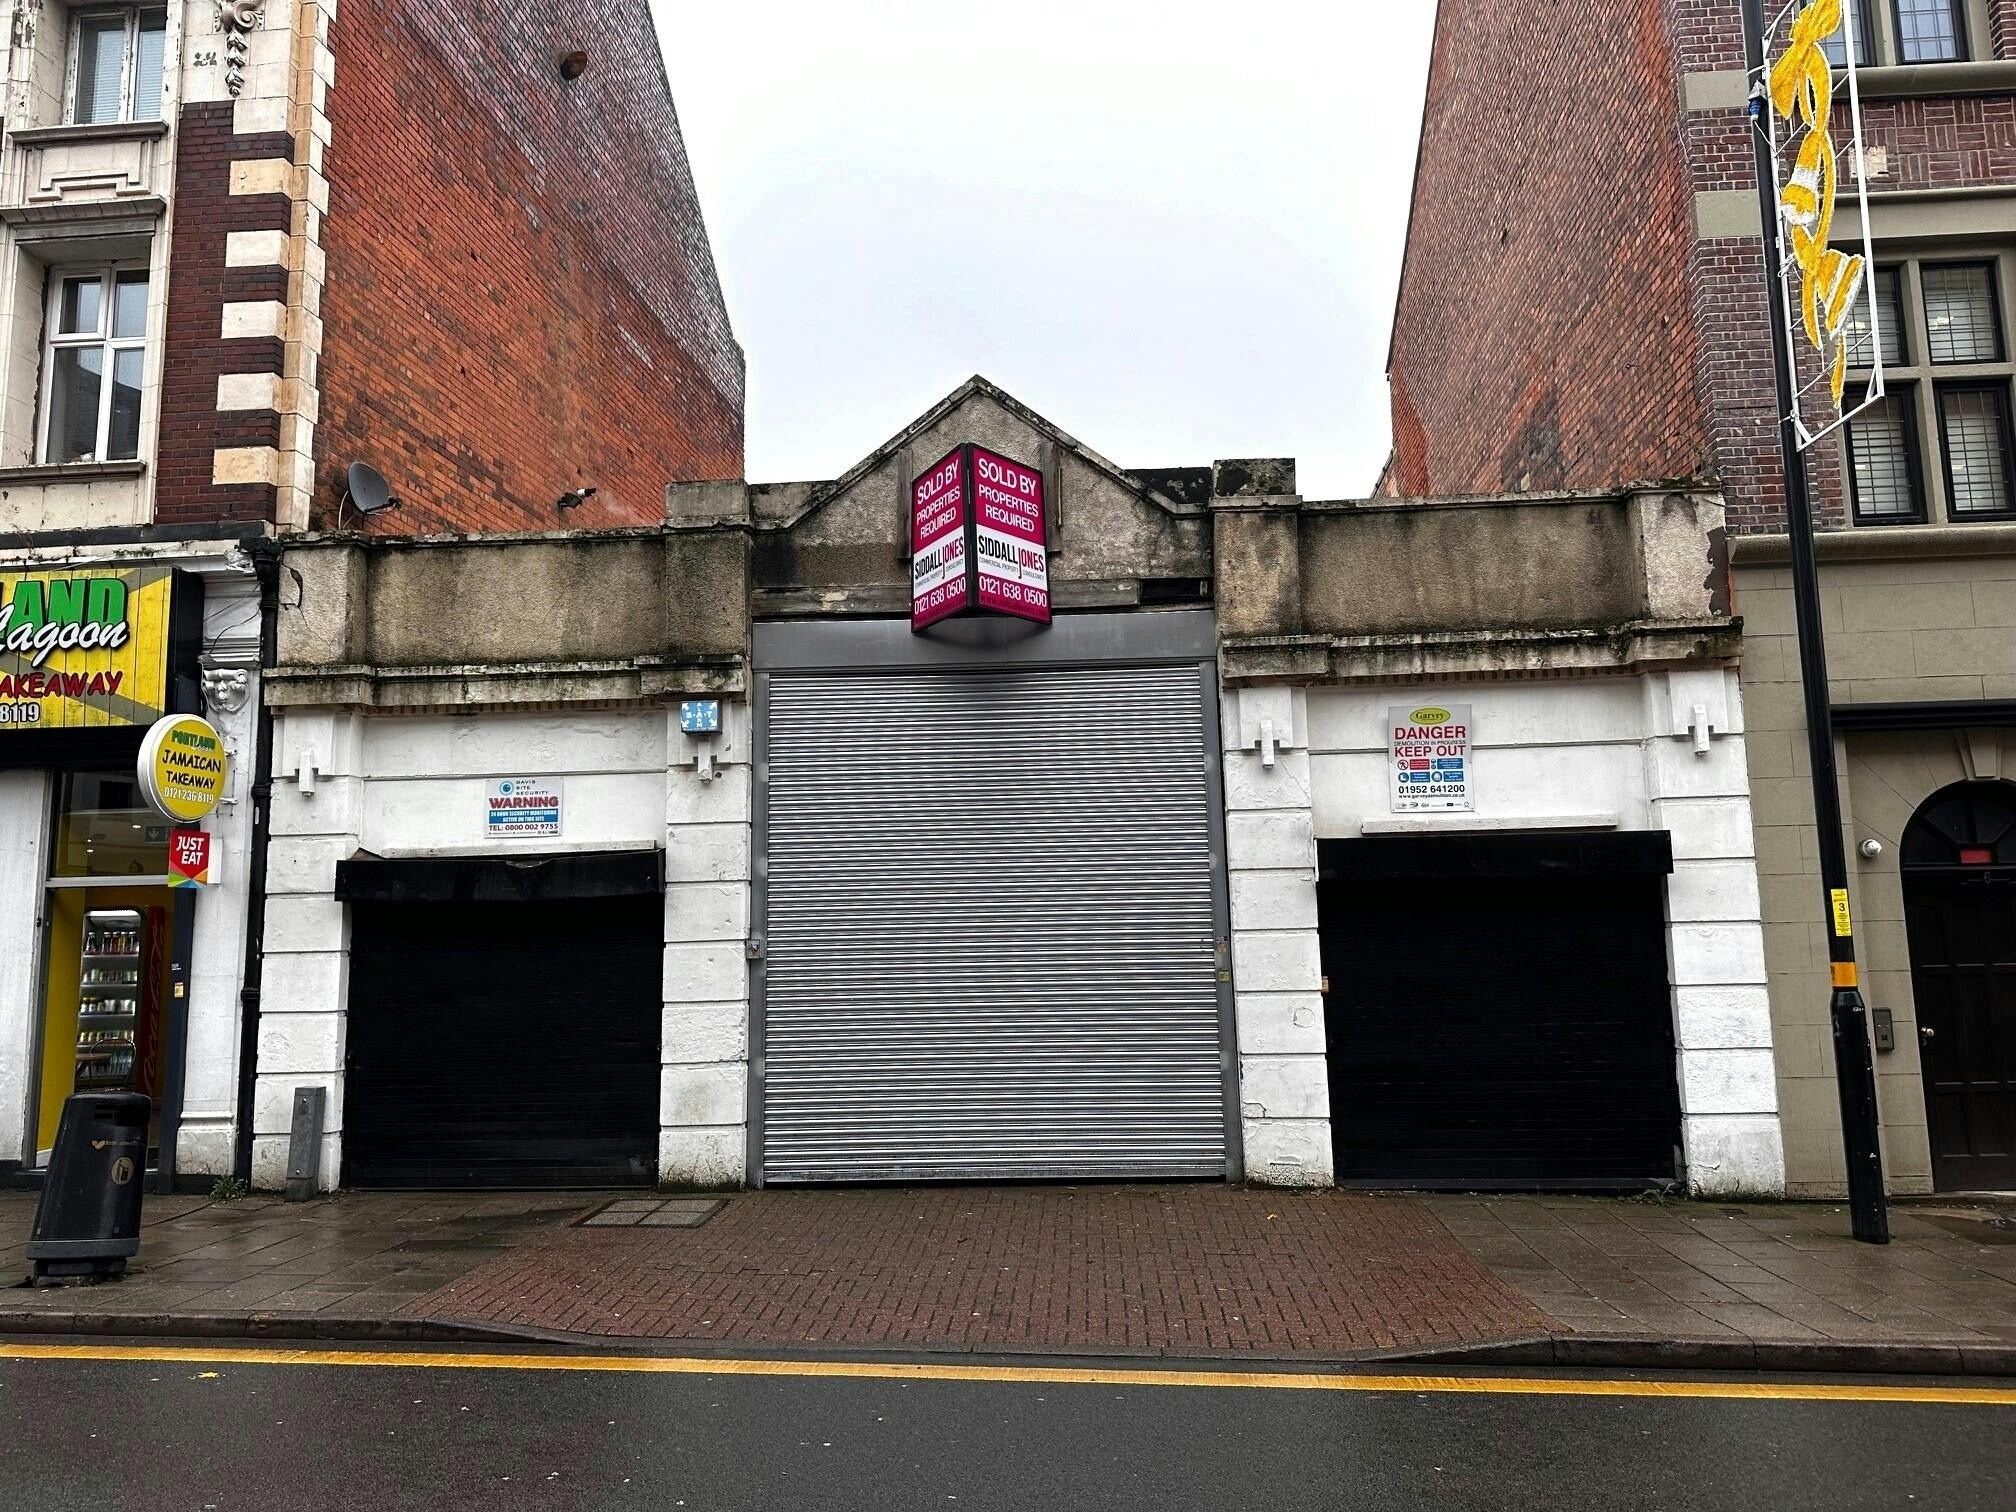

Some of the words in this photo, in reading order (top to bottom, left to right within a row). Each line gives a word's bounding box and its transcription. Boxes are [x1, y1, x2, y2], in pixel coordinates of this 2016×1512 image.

[917, 471, 943, 505] SOLD
[945, 459, 959, 485] BY
[978, 457, 1017, 489] SOLD
[1020, 474, 1036, 497] BY
[917, 485, 961, 525] PROPERTIES
[979, 484, 1039, 517] PROPERTIES
[920, 506, 957, 540] REQUIRED
[985, 504, 1035, 533] REQUIRED
[915, 548, 942, 580] SIDDALL
[942, 535, 964, 579] JONES
[978, 535, 1018, 565] SIDDALL
[1018, 547, 1044, 579] JONES
[979, 556, 1001, 569] COMMERCIAL
[914, 596, 929, 615] 0121
[930, 589, 945, 608] 638
[946, 577, 966, 598] 0500
[979, 576, 1000, 595] 0121
[1002, 582, 1021, 601] 638
[1023, 588, 1047, 608] 0500
[0, 578, 127, 640] AND
[0, 702, 40, 723] 8119
[1415, 711, 1444, 720] Garvey
[1394, 726, 1466, 740] DANGER
[162, 749, 221, 774] JAMAICAN
[1394, 746, 1432, 757] KEEP
[1436, 745, 1466, 756] OUT
[166, 770, 215, 790] TAKEAWAY
[1398, 785, 1428, 794] 01952
[1430, 784, 1465, 793] 641200
[164, 786, 181, 799] 0121
[182, 789, 197, 801] 236
[197, 791, 214, 804] 8119
[488, 796, 559, 809] WARNING
[176, 835, 205, 852] JUST
[181, 850, 203, 866] EAT
[1838, 902, 1846, 912] 3
